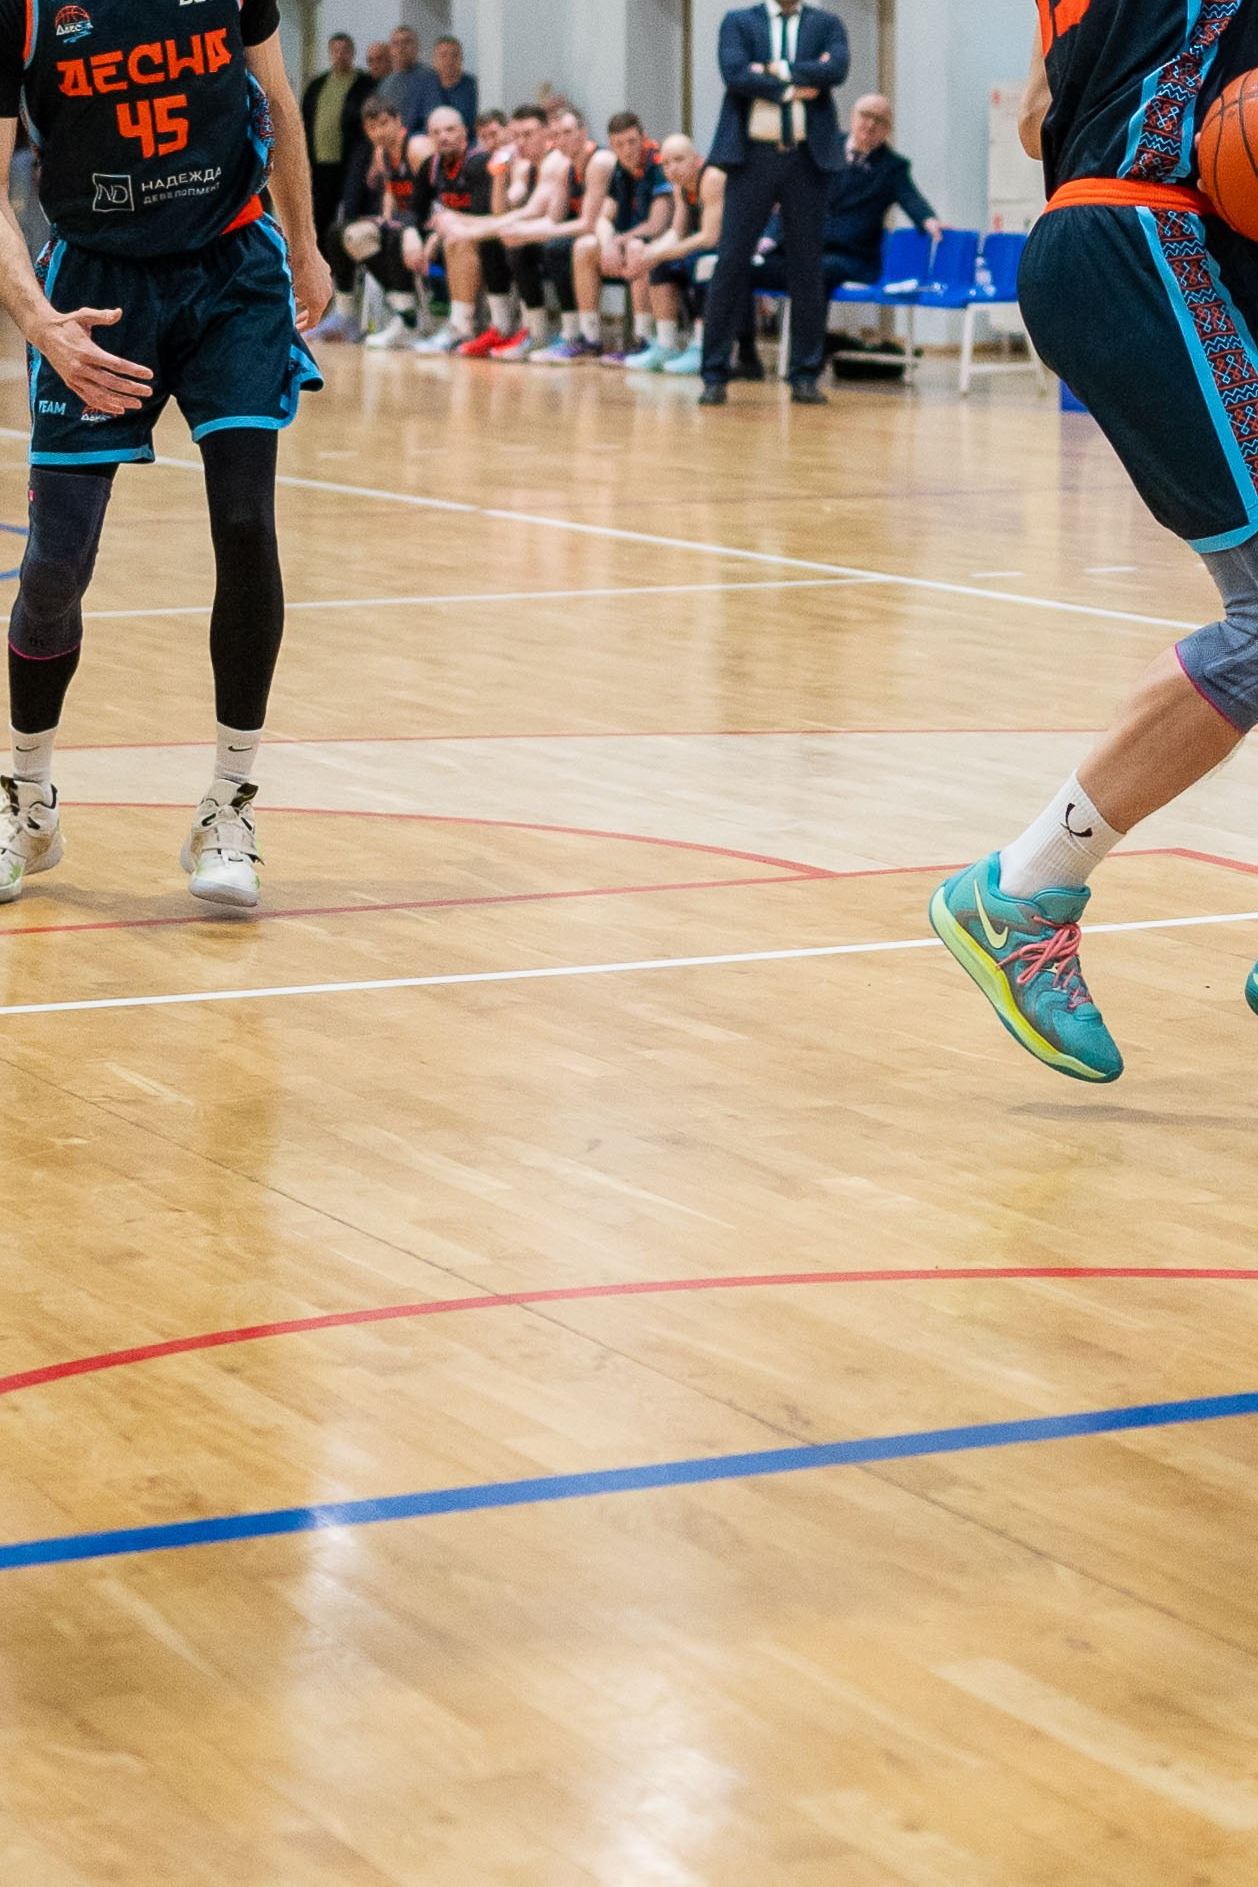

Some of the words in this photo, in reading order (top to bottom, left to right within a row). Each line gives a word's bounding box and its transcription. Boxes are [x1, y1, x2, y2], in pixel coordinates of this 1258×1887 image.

[116, 94, 189, 159] 45
[141, 167, 222, 192] НАДЕЖДА
[38, 399, 66, 416] TEAM
